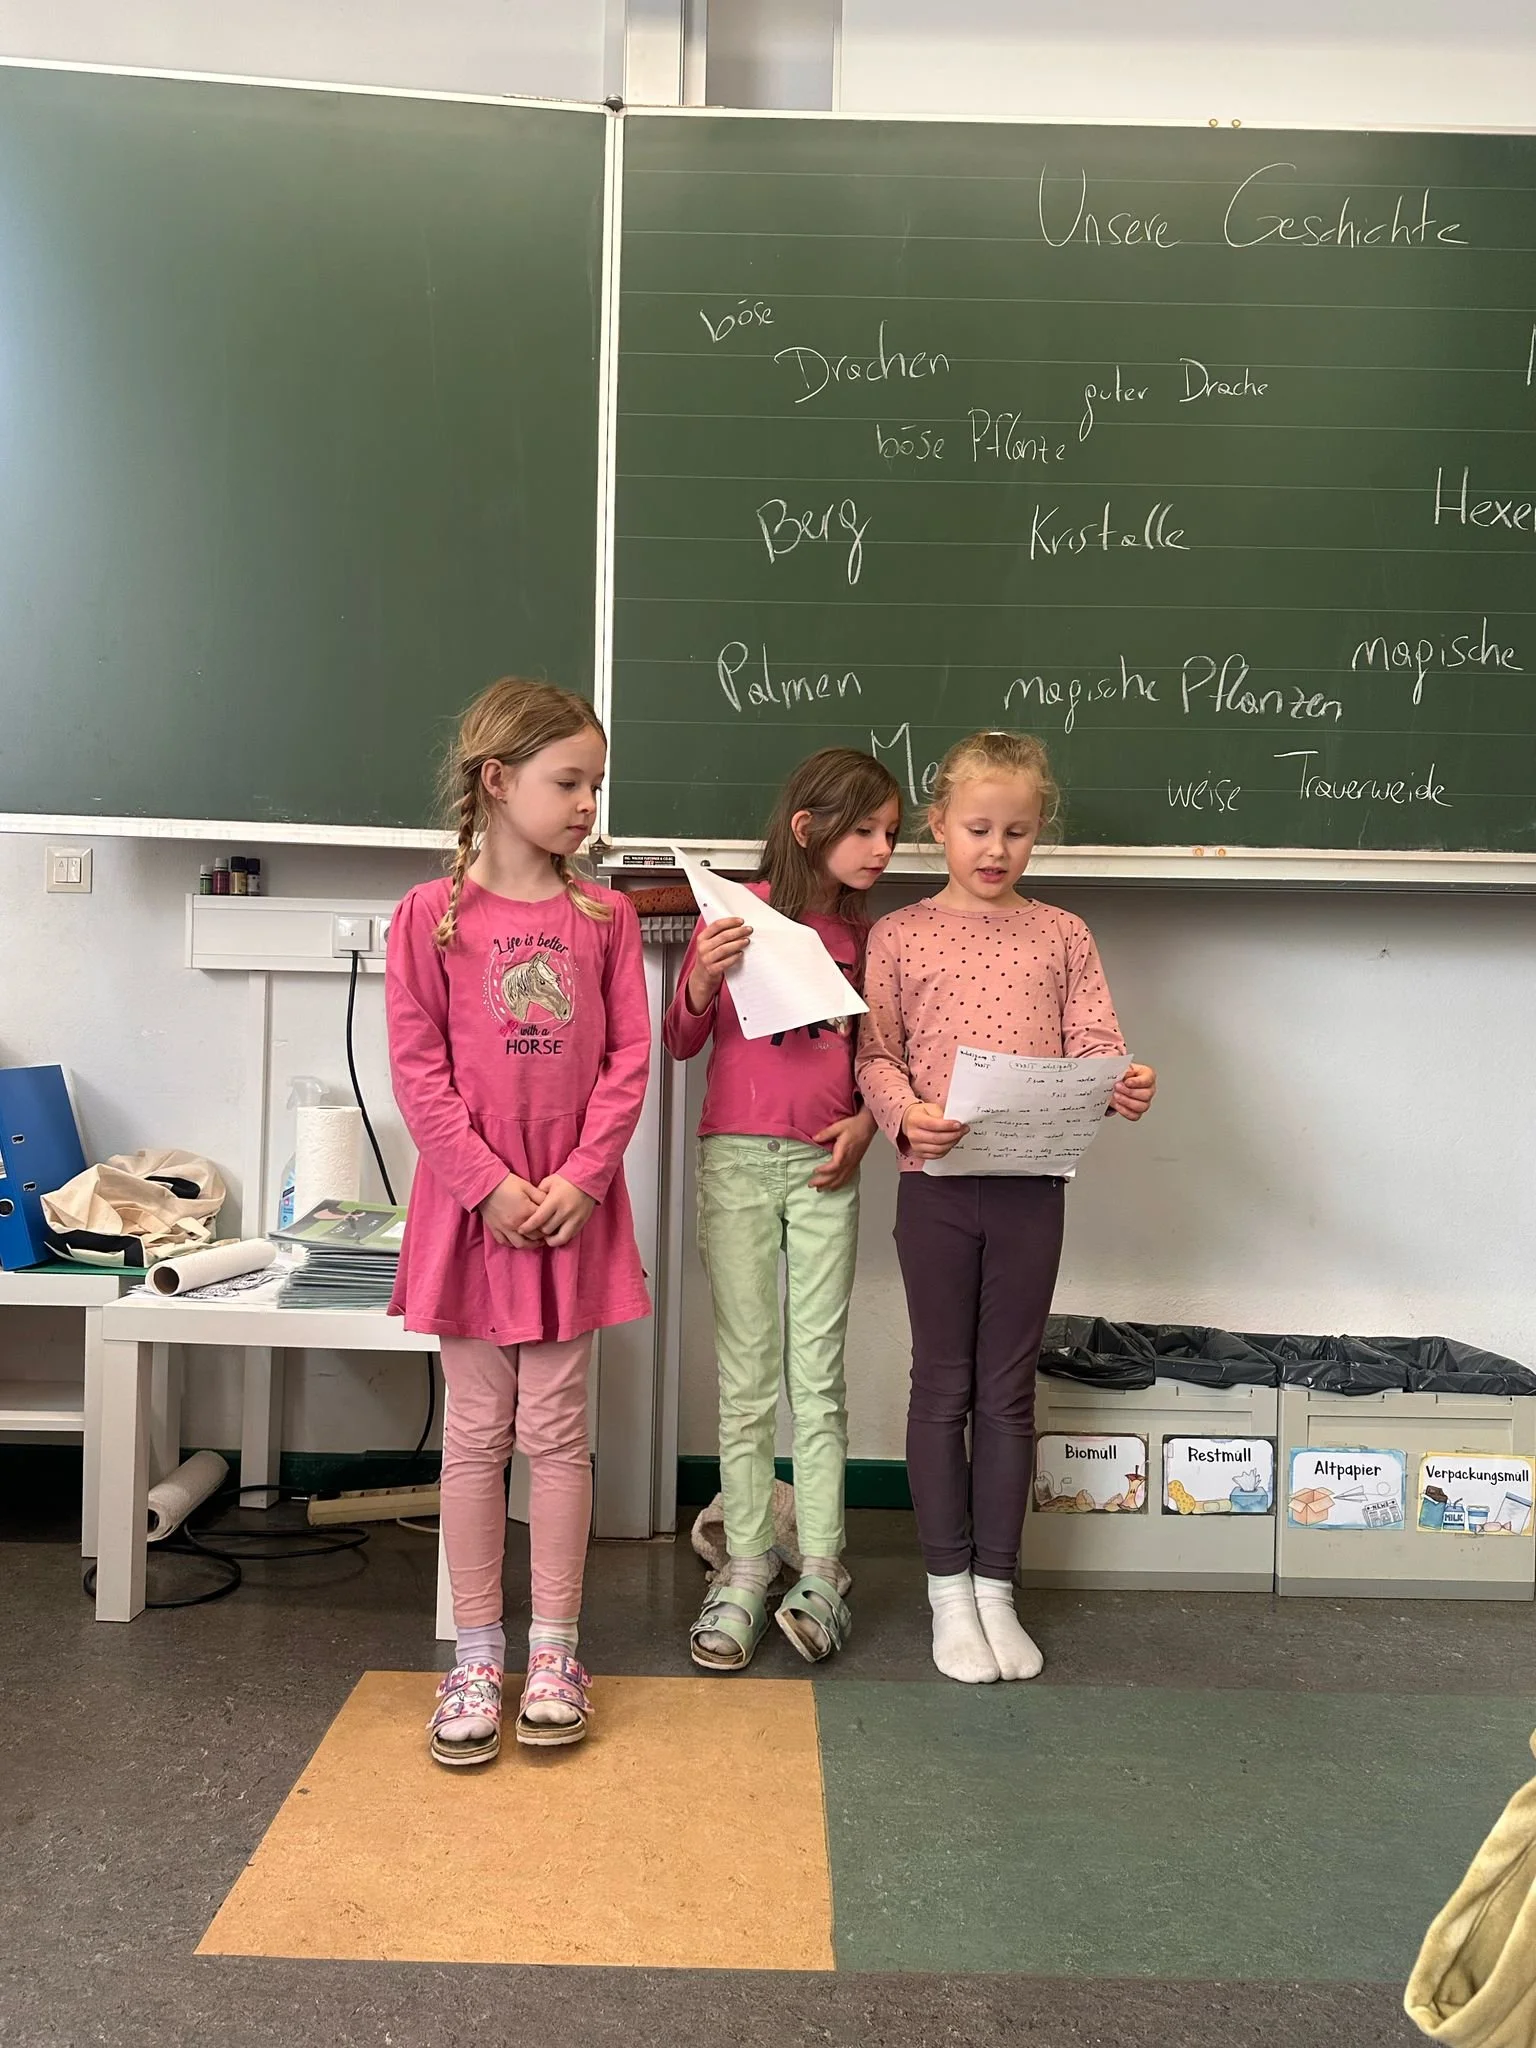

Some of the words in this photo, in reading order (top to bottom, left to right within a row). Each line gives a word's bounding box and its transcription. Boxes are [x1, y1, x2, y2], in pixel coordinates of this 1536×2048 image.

[1038, 161, 1183, 248] Unsere
[1224, 162, 1470, 249] Geschichte
[699, 299, 776, 343] böse
[773, 319, 951, 404] Drachen
[1078, 364, 1149, 442] guter
[1178, 357, 1269, 403] Drache
[876, 424, 946, 462] böse
[967, 407, 1066, 464] Pflanze
[1434, 465, 1536, 533] Hexe
[756, 498, 872, 585] Berg
[1030, 501, 1191, 561] Kristalle
[717, 640, 863, 713] Palmen
[1180, 652, 1344, 724] Pflanzen
[870, 722, 939, 806] Me
[1167, 770, 1243, 812] weise
[1273, 750, 1454, 808] Trauerweide
[493, 936, 523, 956] Life
[524, 933, 534, 947] is
[537, 932, 568, 954] better
[505, 1039, 564, 1055] HORSE
[520, 1024, 540, 1036] with
[541, 1028, 550, 1036] a
[1065, 1443, 1118, 1460] Biomüll
[1187, 1446, 1252, 1463] Restmüll
[1314, 1460, 1382, 1481] Altpapier
[1425, 1465, 1530, 1485] Verpackungsmüll
[1444, 1513, 1463, 1522] MILK
